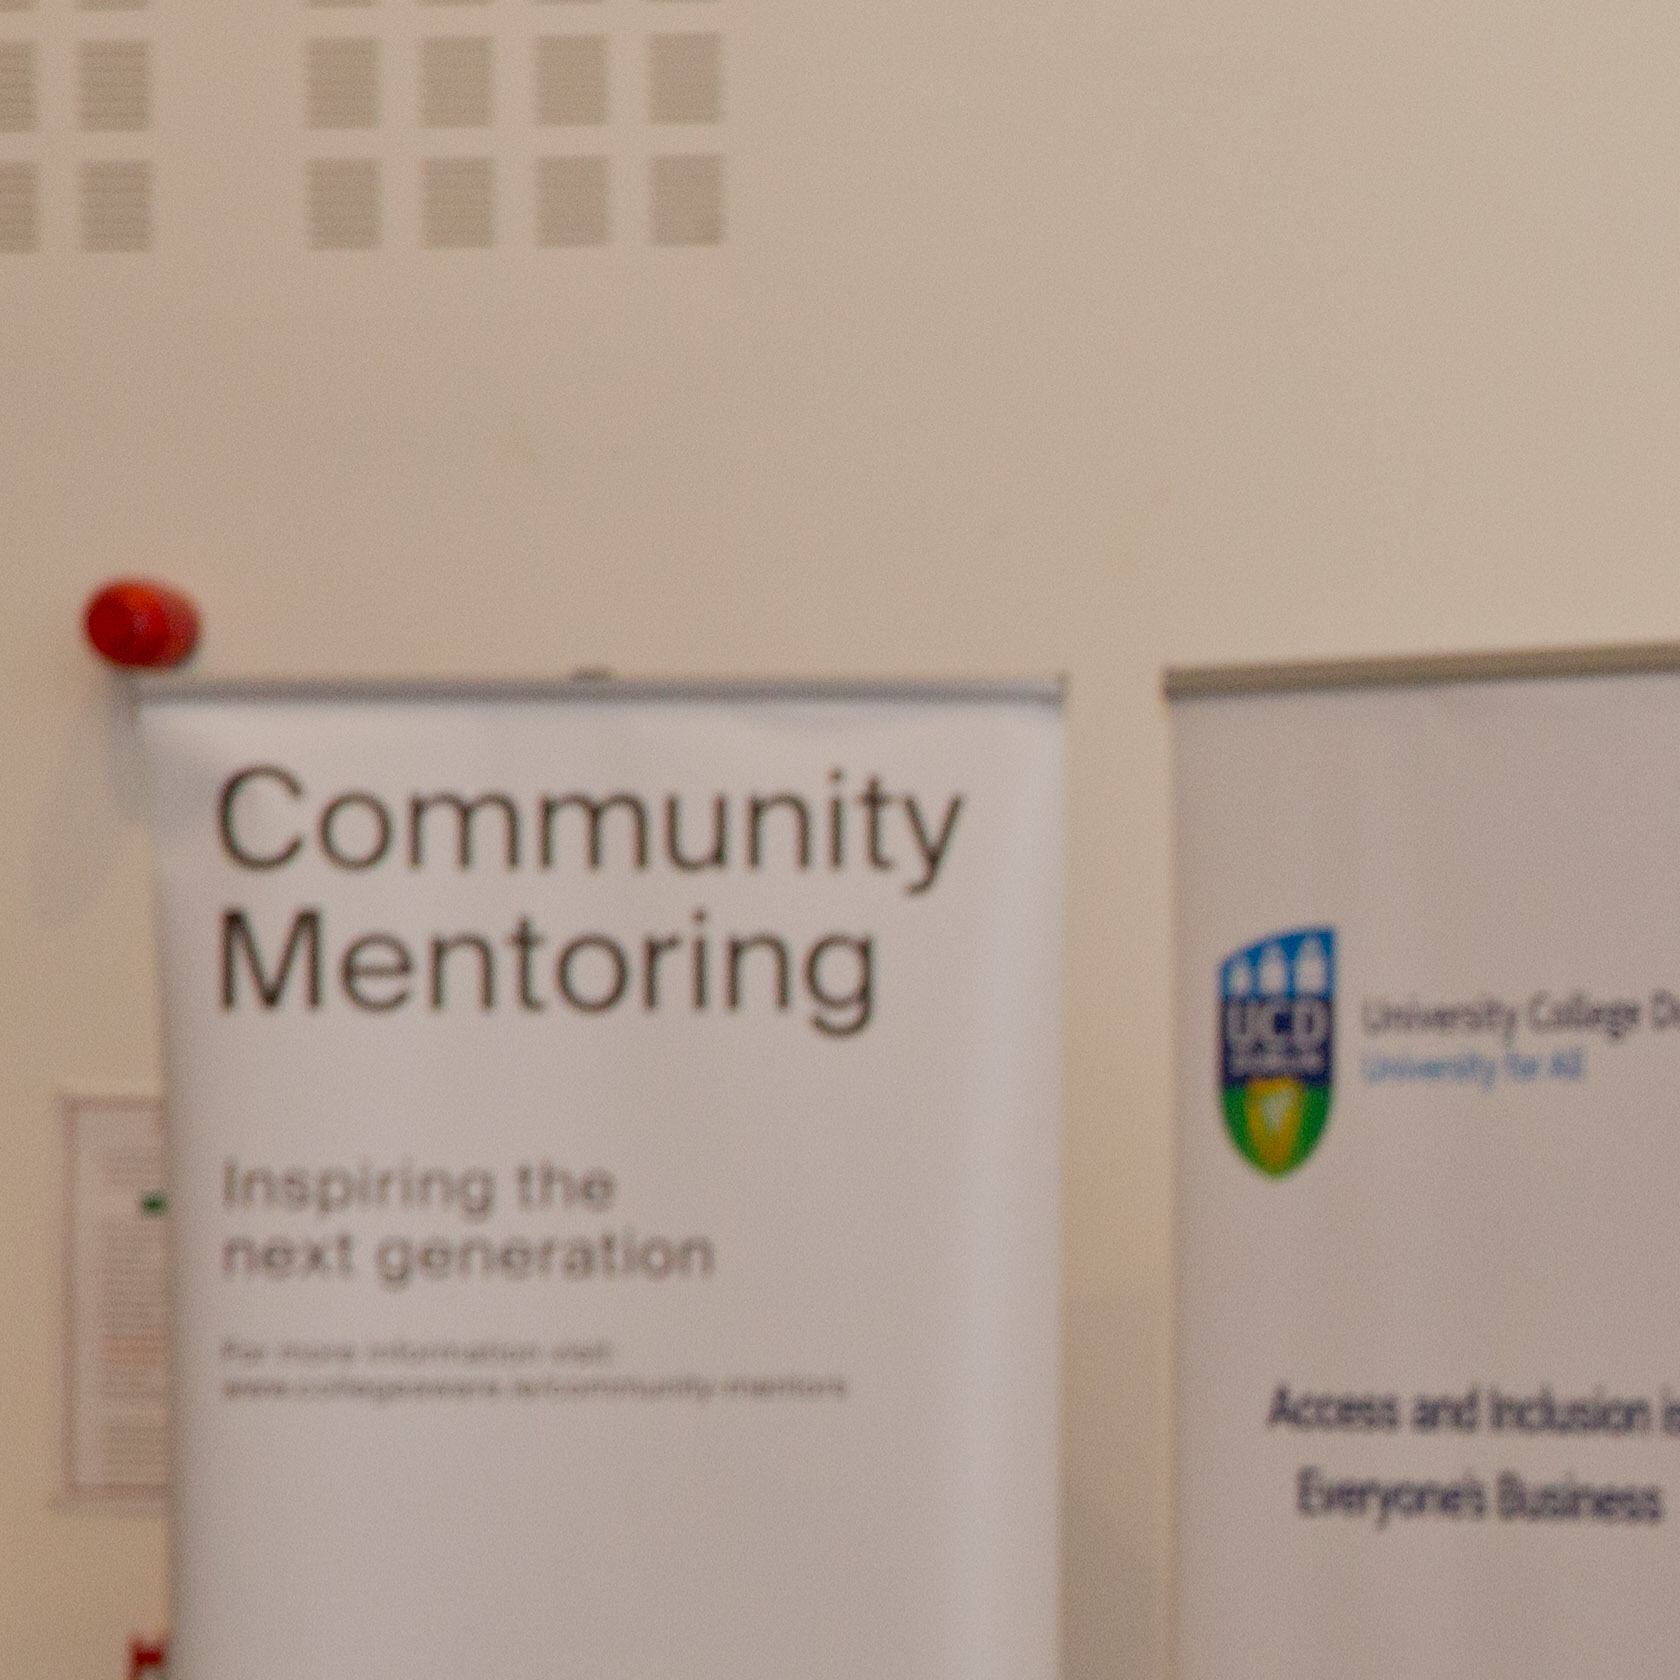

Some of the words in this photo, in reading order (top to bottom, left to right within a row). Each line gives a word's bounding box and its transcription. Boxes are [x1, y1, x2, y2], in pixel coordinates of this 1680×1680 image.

[212, 763, 965, 897] Community
[216, 904, 876, 1040] Mentoring
[1360, 990, 1521, 1045] University
[1526, 988, 1643, 1044] College
[1360, 1046, 1499, 1092] University
[219, 1154, 497, 1224] Inspiring
[514, 1160, 618, 1214] the
[219, 1230, 355, 1281] next
[374, 1228, 717, 1292] generation
[1266, 1380, 1402, 1434] Access
[1409, 1384, 1481, 1436] and
[1486, 1384, 1656, 1438] Inclusion
[1494, 1468, 1666, 1526] Business
